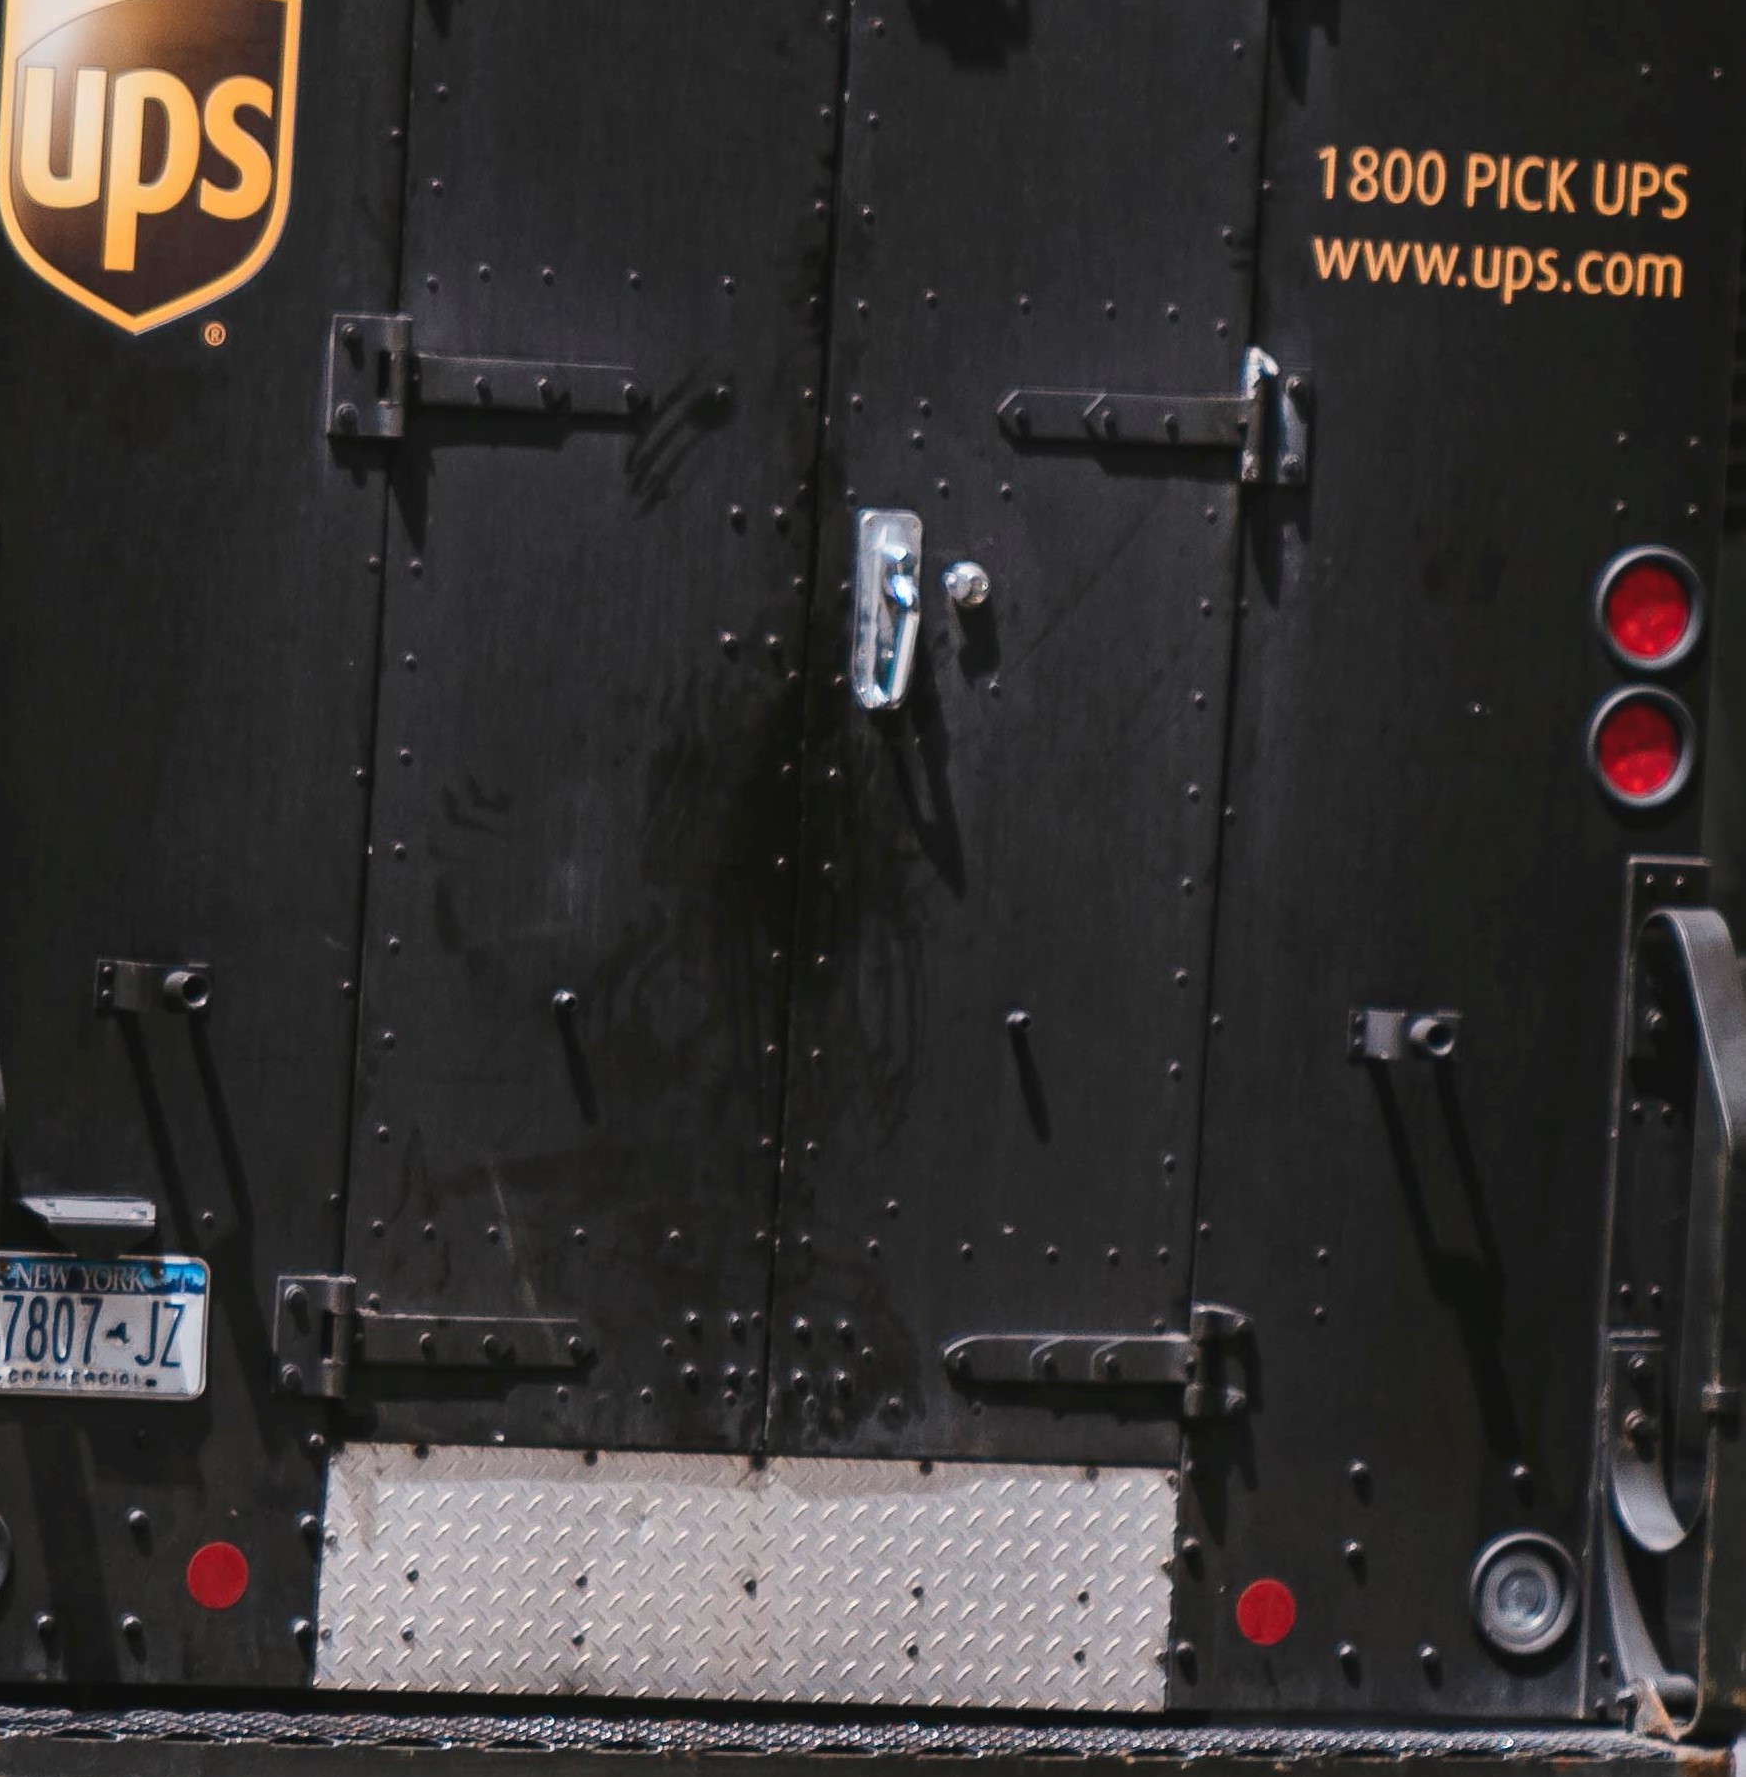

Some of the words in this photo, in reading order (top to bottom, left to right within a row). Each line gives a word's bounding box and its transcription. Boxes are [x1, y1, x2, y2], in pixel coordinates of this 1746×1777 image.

[20, 65, 274, 272] ups
[1317, 145, 1448, 207] 1800
[1464, 151, 1579, 214] PICK
[1593, 160, 1689, 221] UPS
[1312, 235, 1684, 306] www.ups.com
[14, 1261, 70, 1290] NEW
[81, 1264, 146, 1293] YORK
